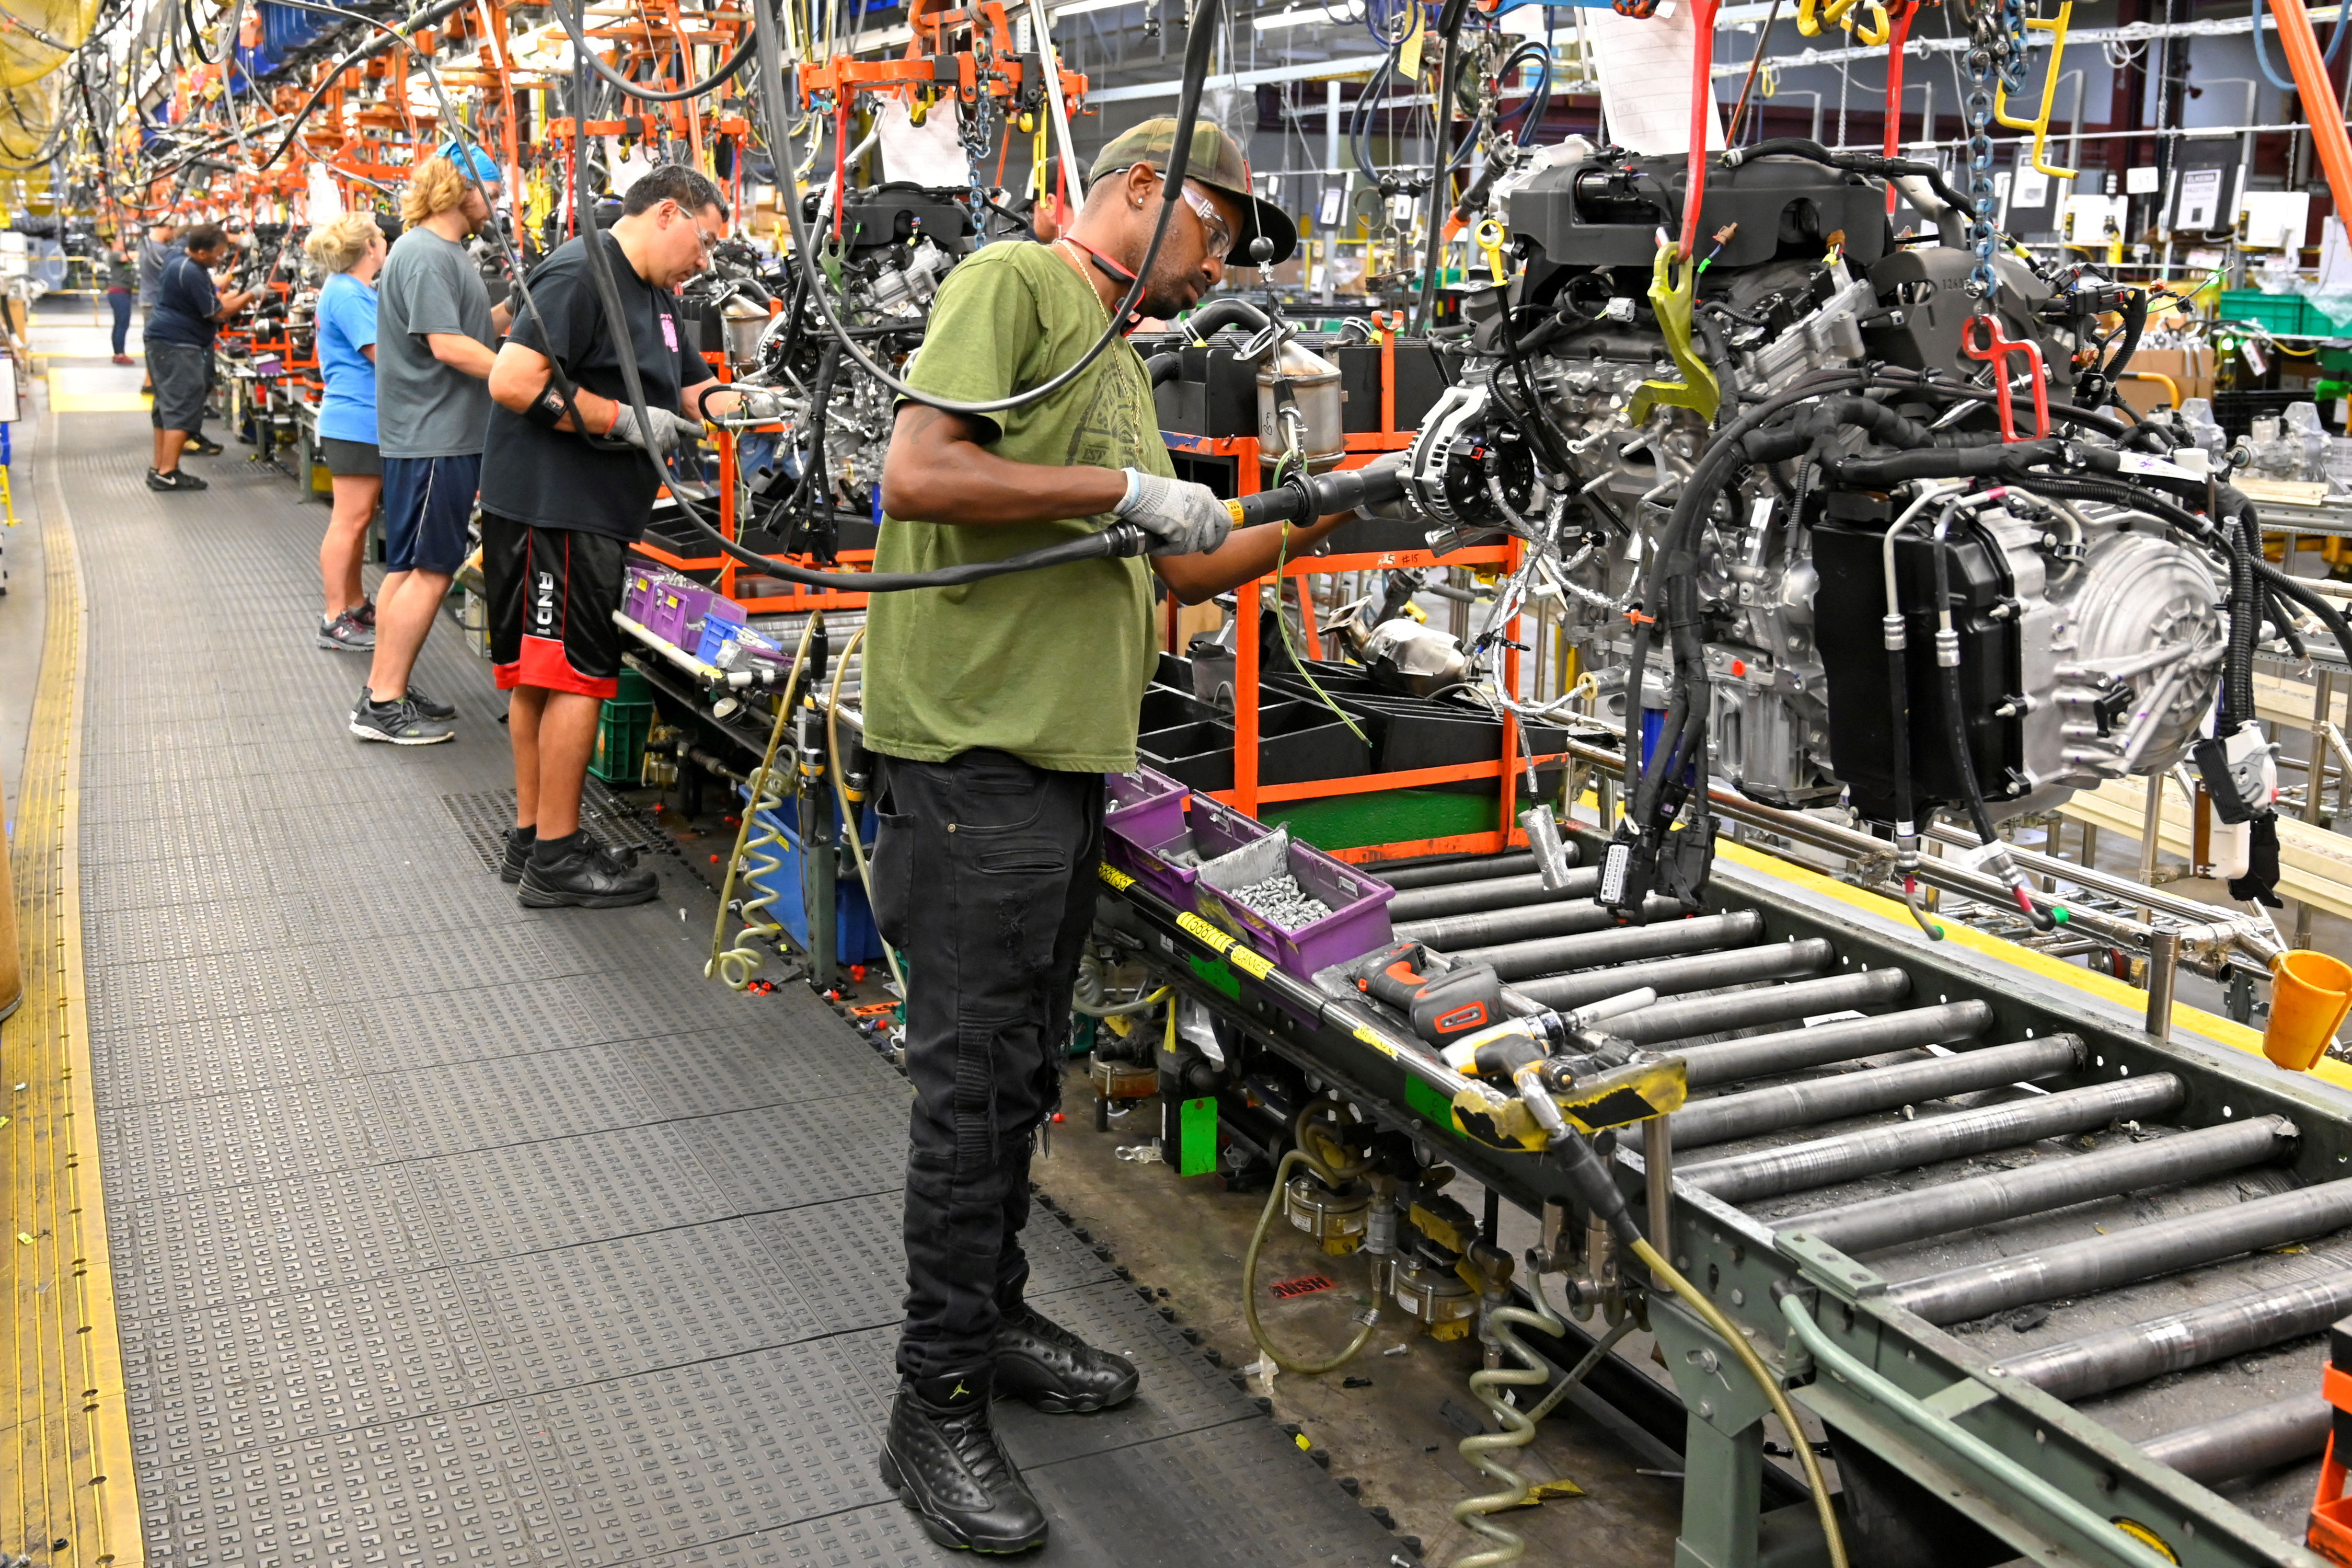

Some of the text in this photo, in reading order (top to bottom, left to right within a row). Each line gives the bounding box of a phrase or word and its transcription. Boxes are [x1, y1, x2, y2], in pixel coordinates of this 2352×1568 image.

[1402, 554, 1420, 566] #15
[1180, 913, 1230, 950] 11588711
[1233, 948, 1269, 975] SCANNER
